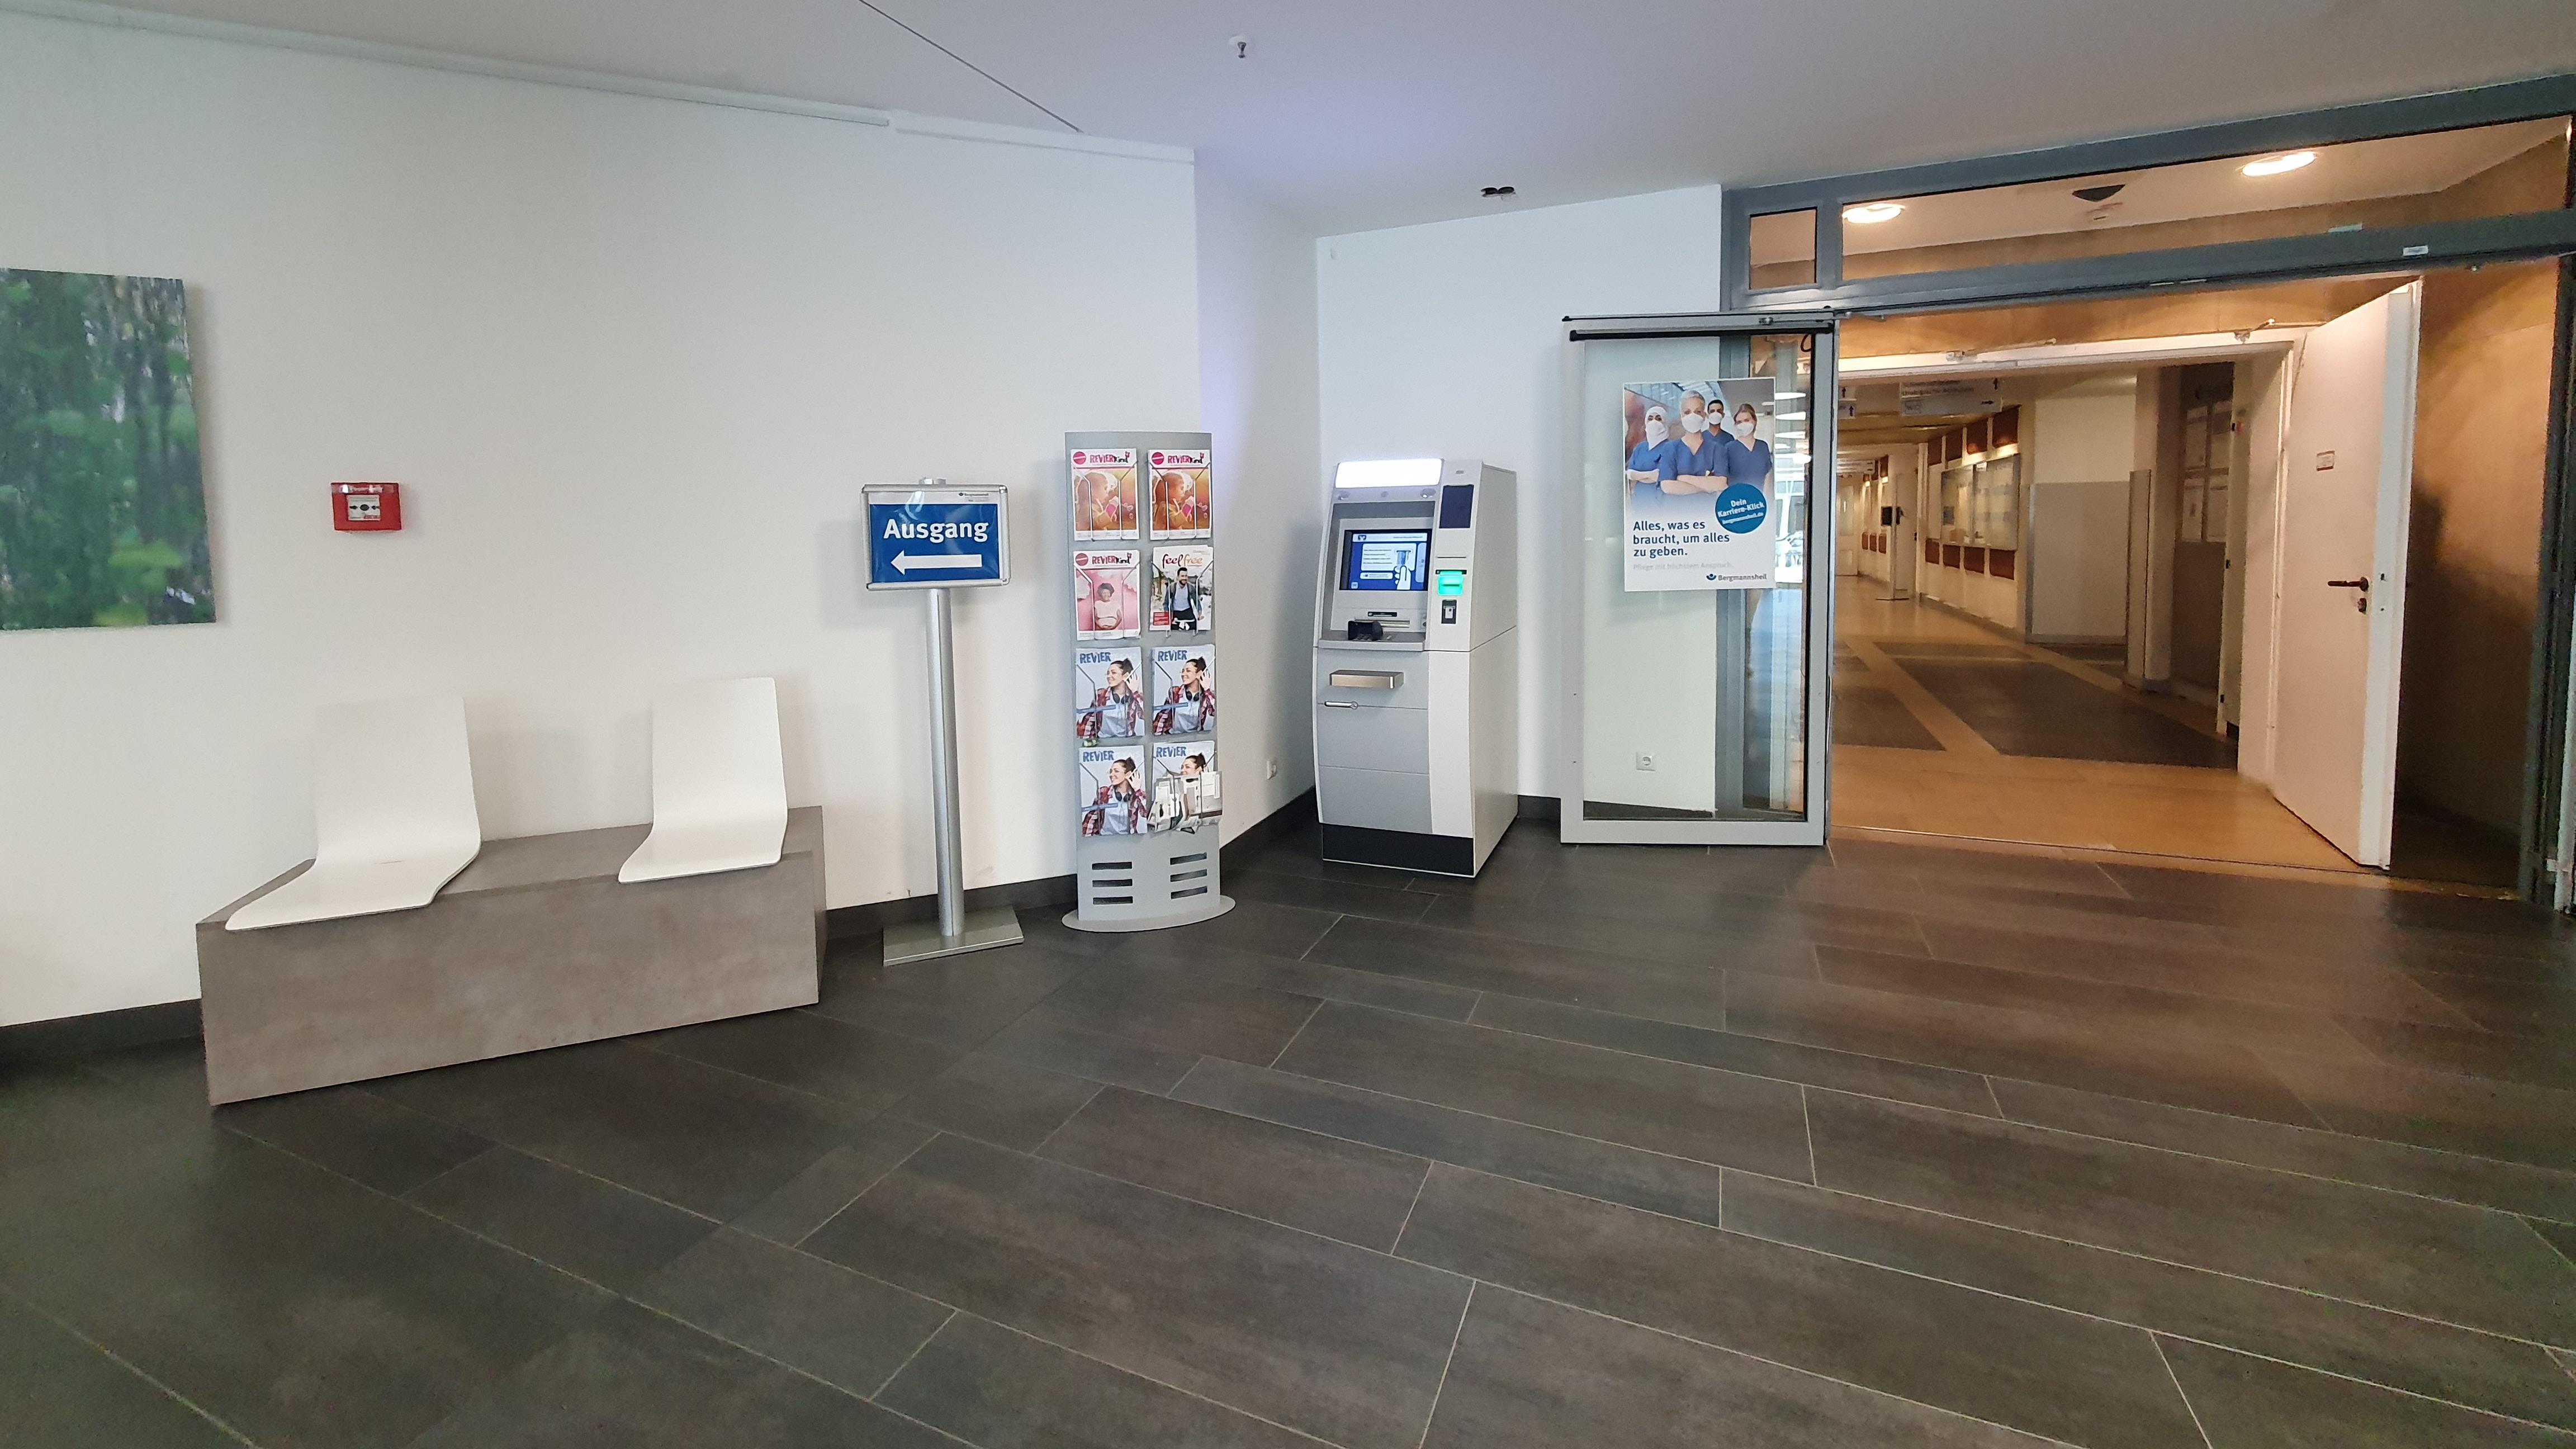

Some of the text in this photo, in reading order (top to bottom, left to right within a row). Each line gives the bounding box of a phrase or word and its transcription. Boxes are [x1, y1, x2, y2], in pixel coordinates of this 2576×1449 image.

[1718, 501, 1764, 517] Karriere-Klick
[1731, 499, 1746, 507] Dein
[883, 519, 989, 543] Ausgang
[1633, 521, 1664, 531] Alles,
[1633, 533, 1730, 545] braucht, um alles
[1633, 546, 1688, 558] zu geben.
[1718, 574, 1767, 582] Bergmannsheil
[1079, 652, 1111, 664] REVIER
[1158, 650, 1187, 662] REVIER
[1083, 750, 1114, 763] REVIER
[1156, 746, 1186, 757] REVIER
